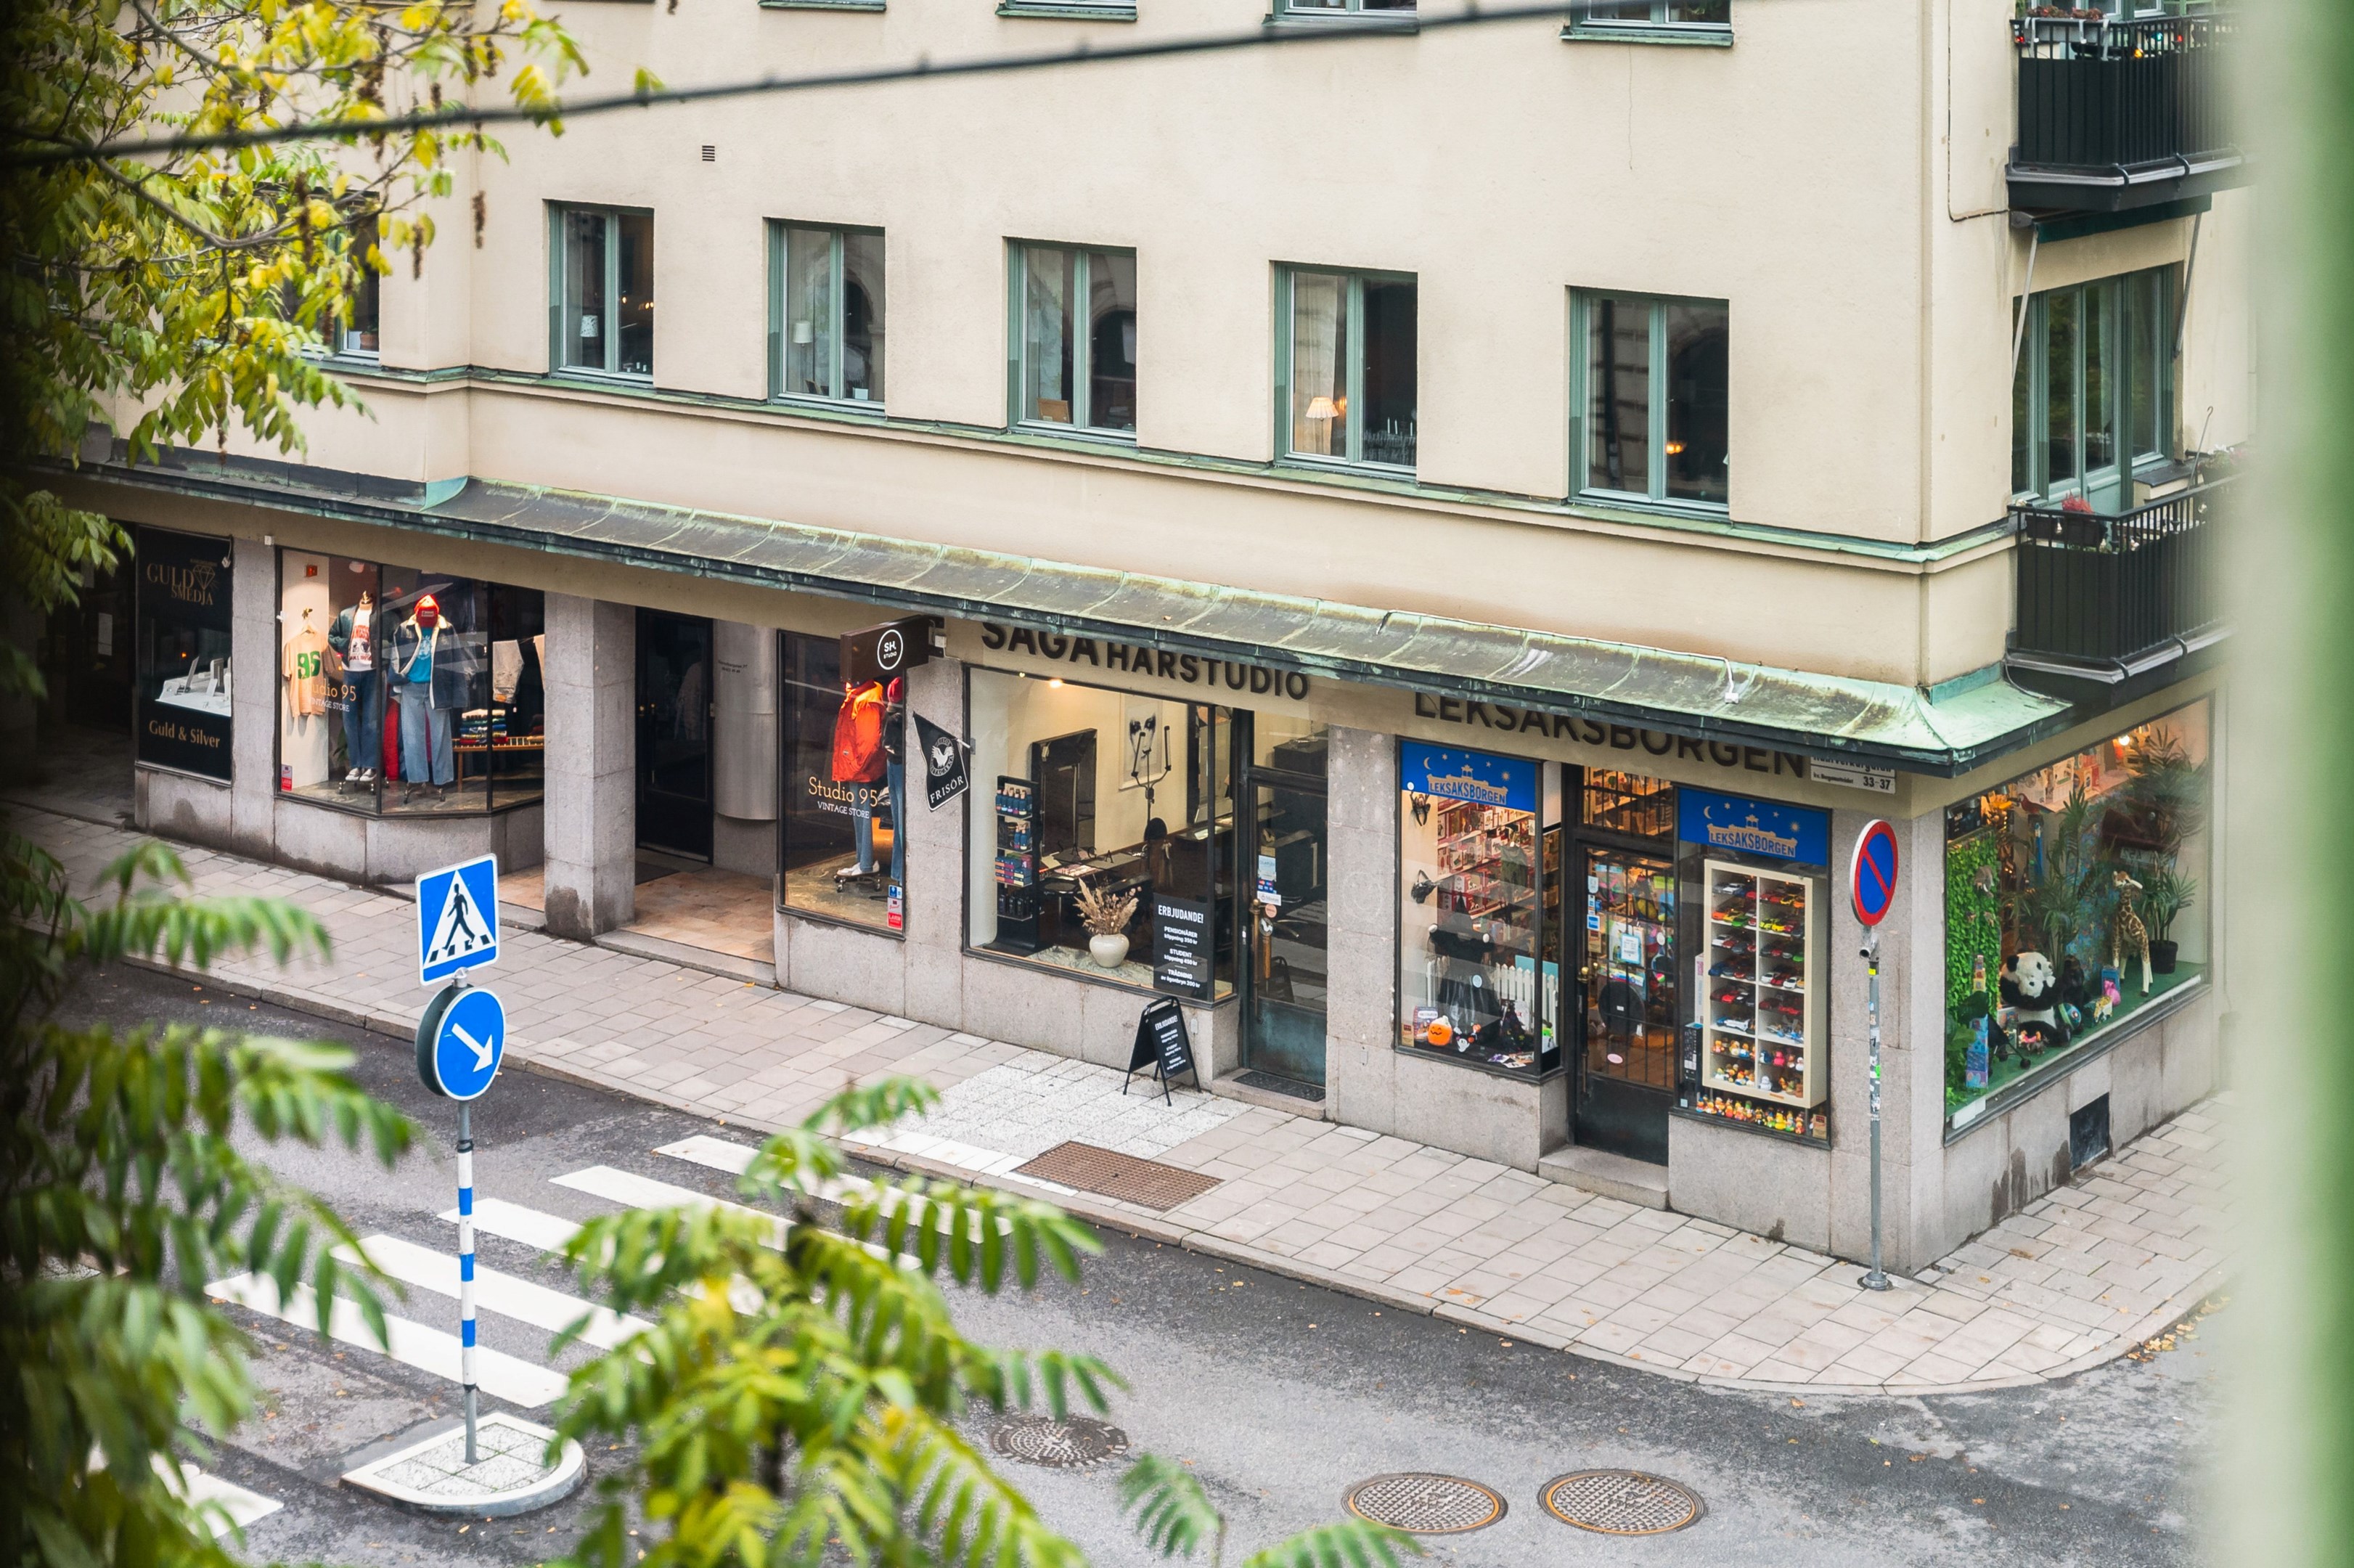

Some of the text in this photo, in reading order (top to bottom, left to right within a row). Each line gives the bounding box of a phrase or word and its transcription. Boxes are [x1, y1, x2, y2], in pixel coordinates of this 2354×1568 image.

[147, 563, 195, 589] GULD
[171, 585, 213, 605] SMEDJA
[981, 621, 1098, 666] SAGA
[341, 684, 356, 701] 95
[332, 702, 350, 712] STORE
[149, 720, 220, 748] Guld & Silver
[808, 776, 879, 807] Studio 95
[930, 775, 964, 804] FRISÖR
[1429, 780, 1506, 804] LEKSAKSBORGEN
[1863, 776, 1891, 791] 33-37
[817, 801, 870, 819] VINTAGE STORE
[1710, 832, 1795, 856] LEKSAKSBORGEN
[1158, 905, 1204, 924] ERBJUDANDE!
[1169, 948, 1192, 957] STUDENT
